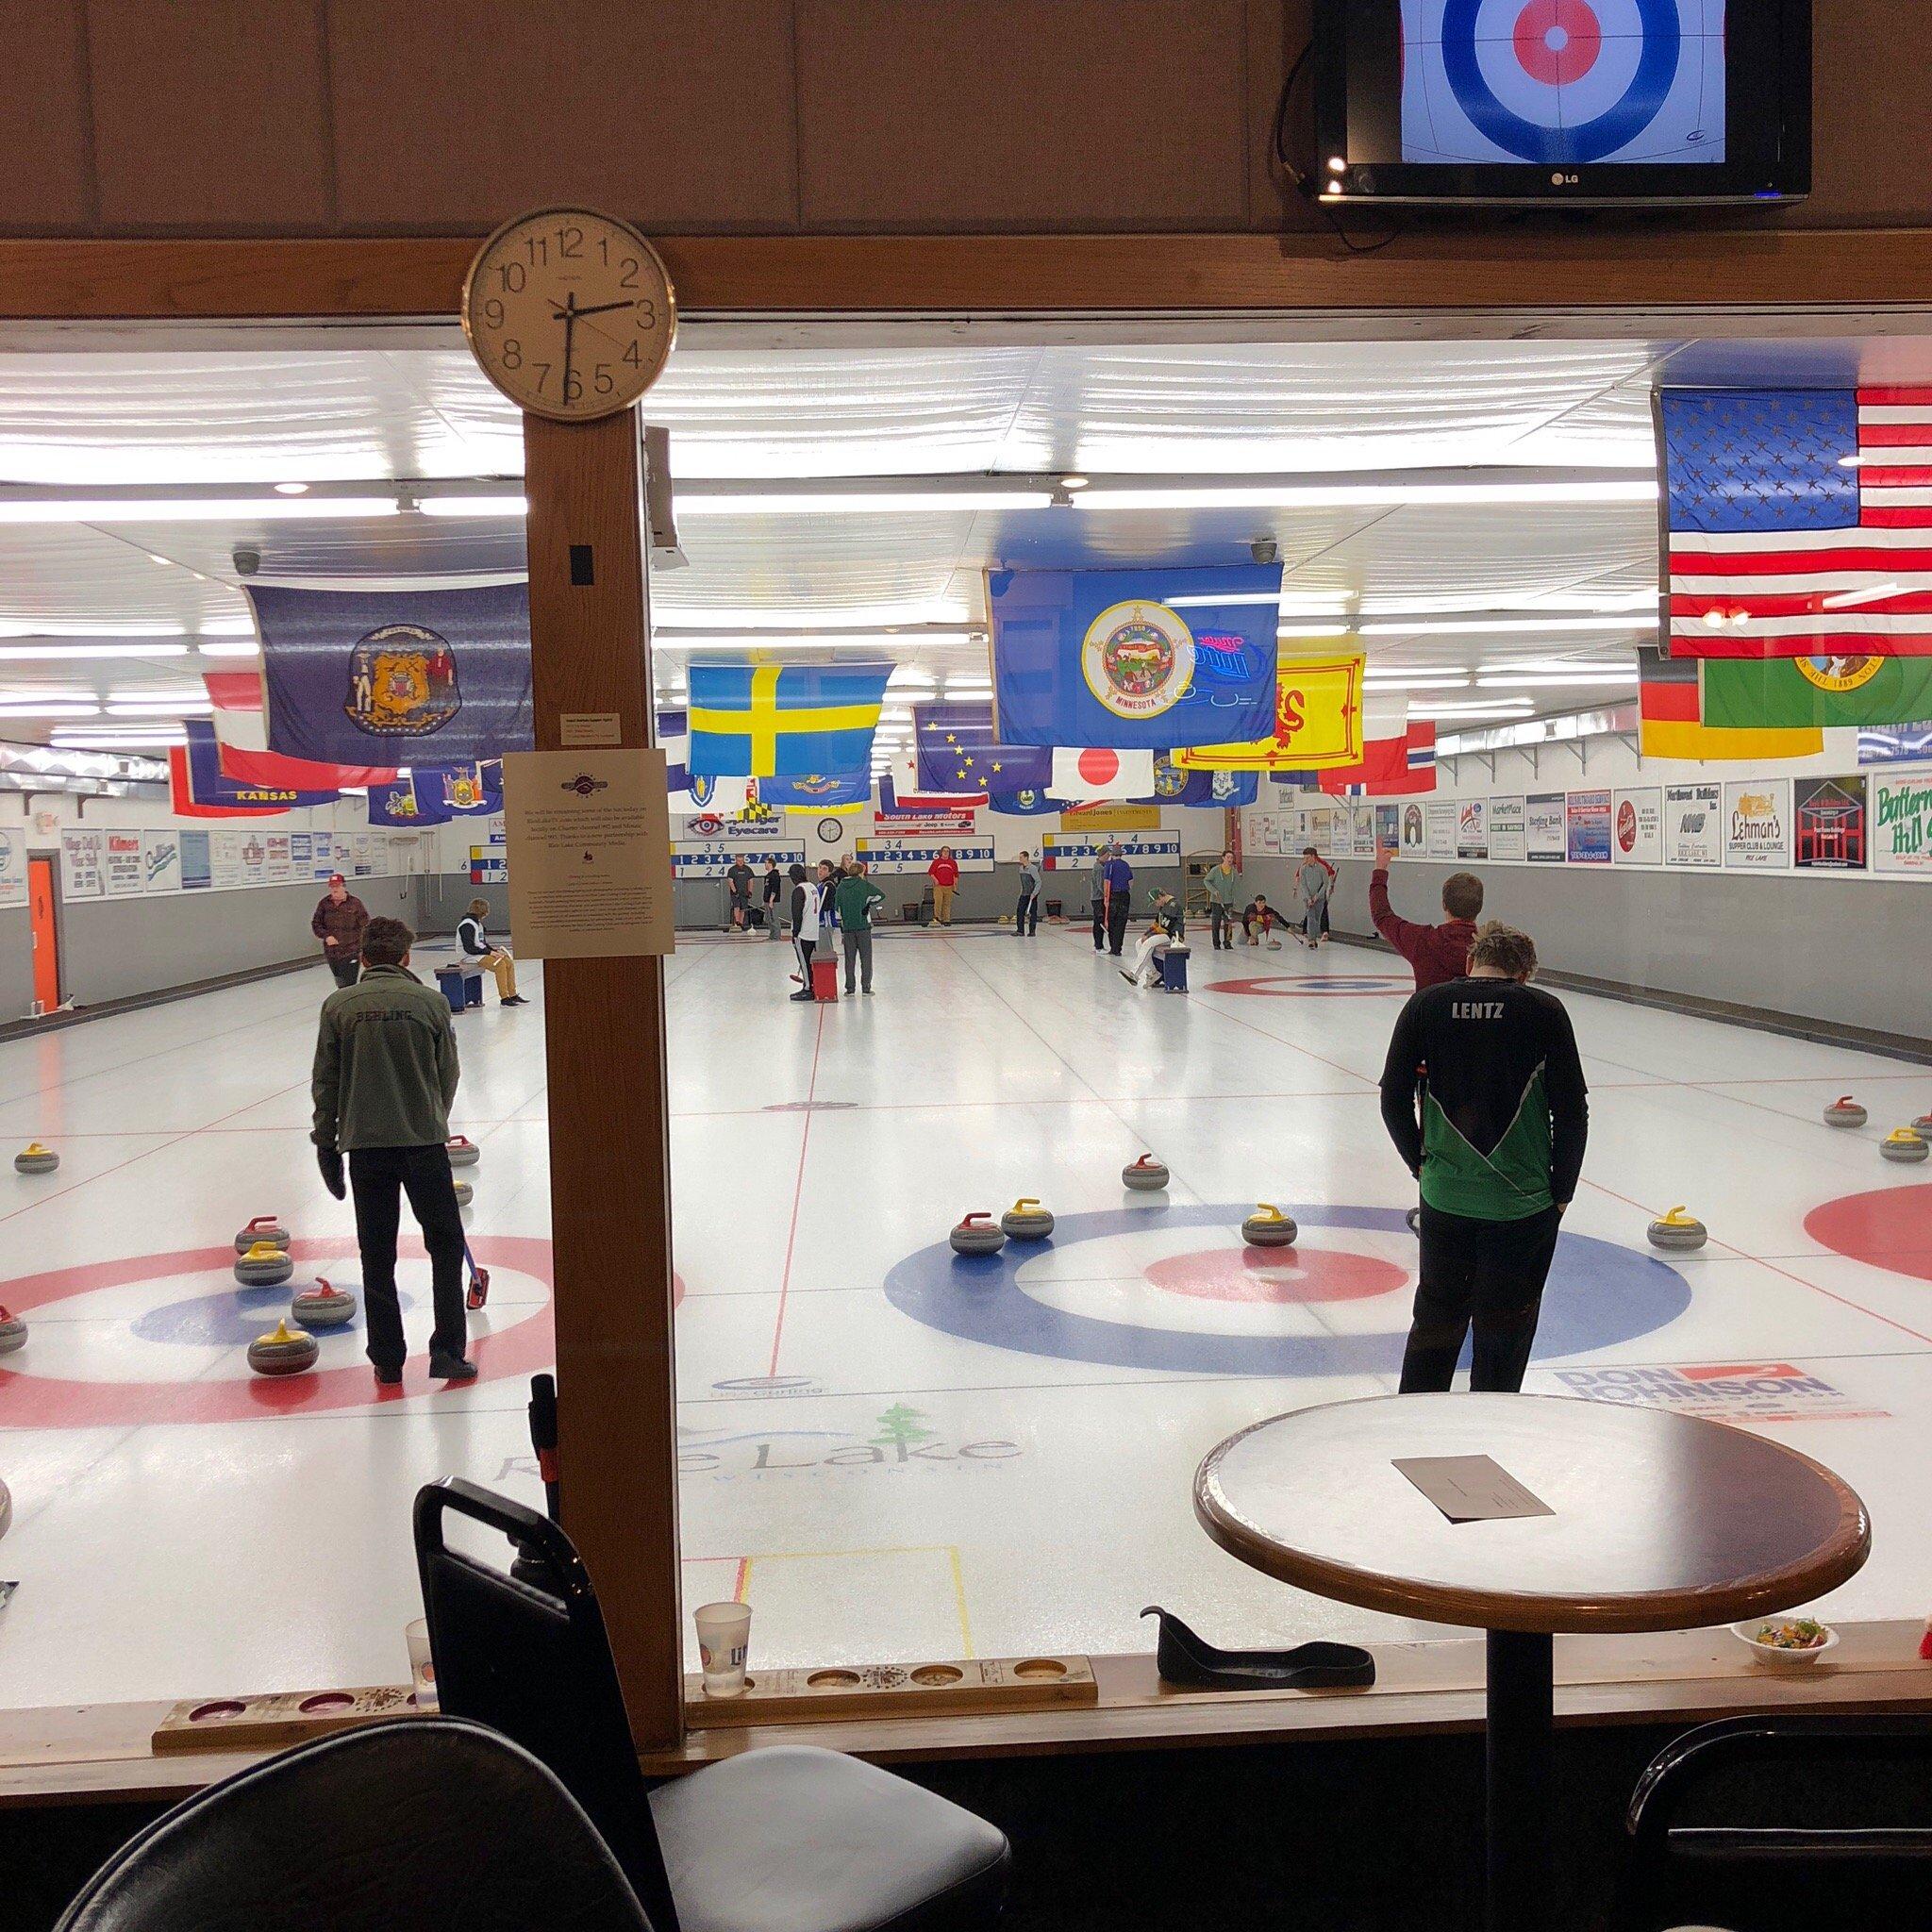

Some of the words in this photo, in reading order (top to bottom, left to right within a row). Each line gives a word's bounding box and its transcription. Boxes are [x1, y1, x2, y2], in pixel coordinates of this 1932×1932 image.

[1565, 175, 1578, 183] LG
[555, 227, 583, 258] 12
[525, 237, 546, 266] 11
[597, 238, 608, 266] 1
[488, 262, 525, 292] 10
[620, 258, 639, 289] 2
[484, 299, 505, 329] 9
[636, 299, 656, 330] 3
[503, 339, 522, 370] 8
[622, 340, 642, 369] 4
[532, 363, 551, 393] 7
[564, 370, 582, 400] 6
[593, 364, 613, 394] 5
[1833, 679, 1854, 689] 1889
[1115, 695, 1157, 709] MINNESOTA
[236, 790, 298, 801] KANSAS
[1667, 790, 1692, 801] Northwest
[1696, 788, 1718, 800] Builders
[1529, 816, 1548, 827] Sterling
[1549, 814, 1562, 827] Bank
[1732, 811, 1780, 841] Lehman's
[728, 826, 779, 836] Eyecare
[1891, 815, 1923, 855] Hill
[885, 840, 891, 849] 3
[895, 840, 903, 849] 4
[1084, 835, 1089, 844] 1
[1108, 834, 1114, 843] 3
[1131, 834, 1138, 843] 4
[1729, 841, 1745, 850] SUPPER
[704, 843, 711, 853] 3
[717, 842, 725, 853] 5
[872, 852, 876, 860] 1
[884, 851, 891, 860] 2
[896, 851, 903, 859] 3
[907, 851, 914, 859] 4
[921, 851, 927, 859] 5
[932, 850, 940, 859] 6
[956, 849, 962, 858] 8
[967, 849, 974, 858] 9
[979, 849, 990, 858] 10
[1033, 847, 1040, 858] 6
[1060, 847, 1064, 857] 1
[1071, 847, 1078, 856] 2
[1083, 846, 1090, 856] 3
[1132, 845, 1138, 854] 7
[1142, 844, 1149, 854] 8
[1154, 844, 1161, 853] 9
[1167, 843, 1176, 853] 10
[460, 860, 467, 870] 6
[487, 859, 491, 869] 1
[499, 859, 506, 869] 2
[679, 855, 684, 865] 1
[691, 855, 698, 864] 2
[704, 855, 711, 864] 3
[717, 855, 724, 864] 4
[730, 855, 736, 863] 5
[744, 855, 751, 863] 6
[756, 854, 762, 863] 7
[781, 853, 788, 861] 9
[793, 853, 803, 861] 10
[1072, 858, 1078, 868] 2
[679, 868, 685, 876] 1
[706, 867, 712, 875] 2
[718, 866, 725, 875] 4
[872, 863, 878, 873] 2
[896, 863, 903, 873] 5
[488, 872, 492, 881] 1
[500, 872, 508, 881] 2
[1452, 1002, 1505, 1020] LENTZ
[1553, 1367, 1683, 1386] DON
[1576, 1376, 1837, 1405] JOHNSON
[751, 1441, 1022, 1470] Lake
